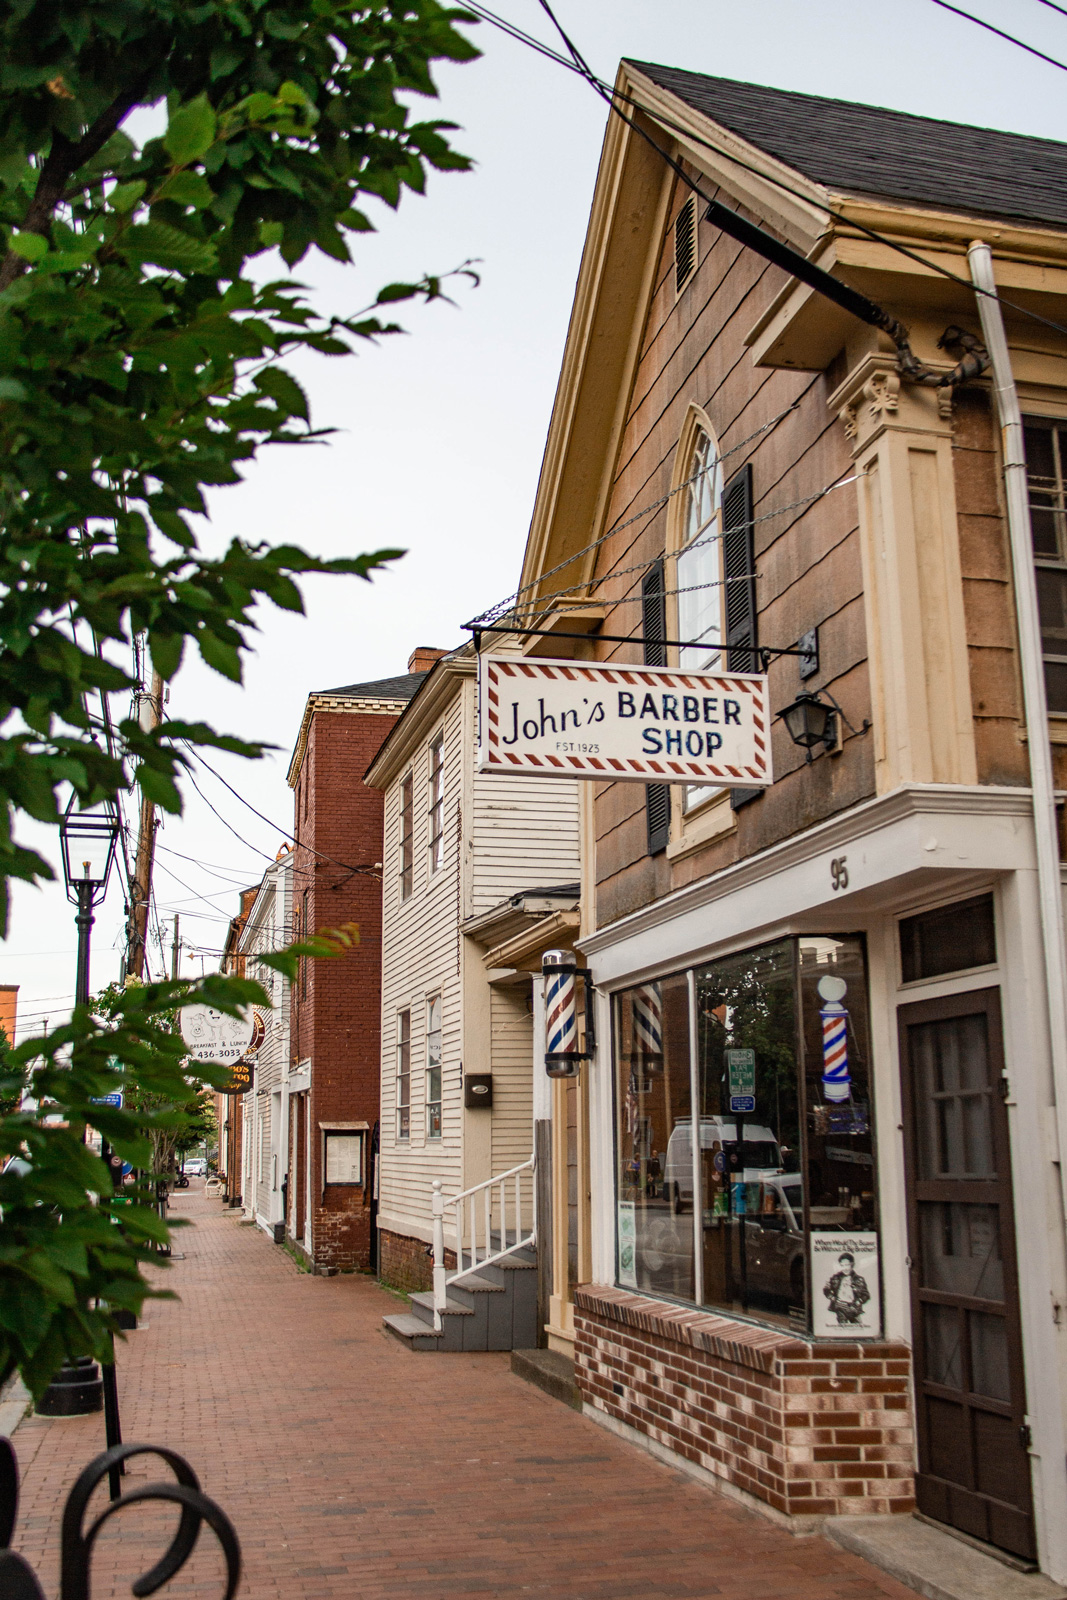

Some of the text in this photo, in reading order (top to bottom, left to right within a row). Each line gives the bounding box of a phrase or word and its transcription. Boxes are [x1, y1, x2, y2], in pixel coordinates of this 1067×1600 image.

[502, 691, 742, 745] John's BARBER
[642, 727, 723, 758] SHOP
[831, 855, 849, 891] 95
[197, 1049, 241, 1058] 436-3033
